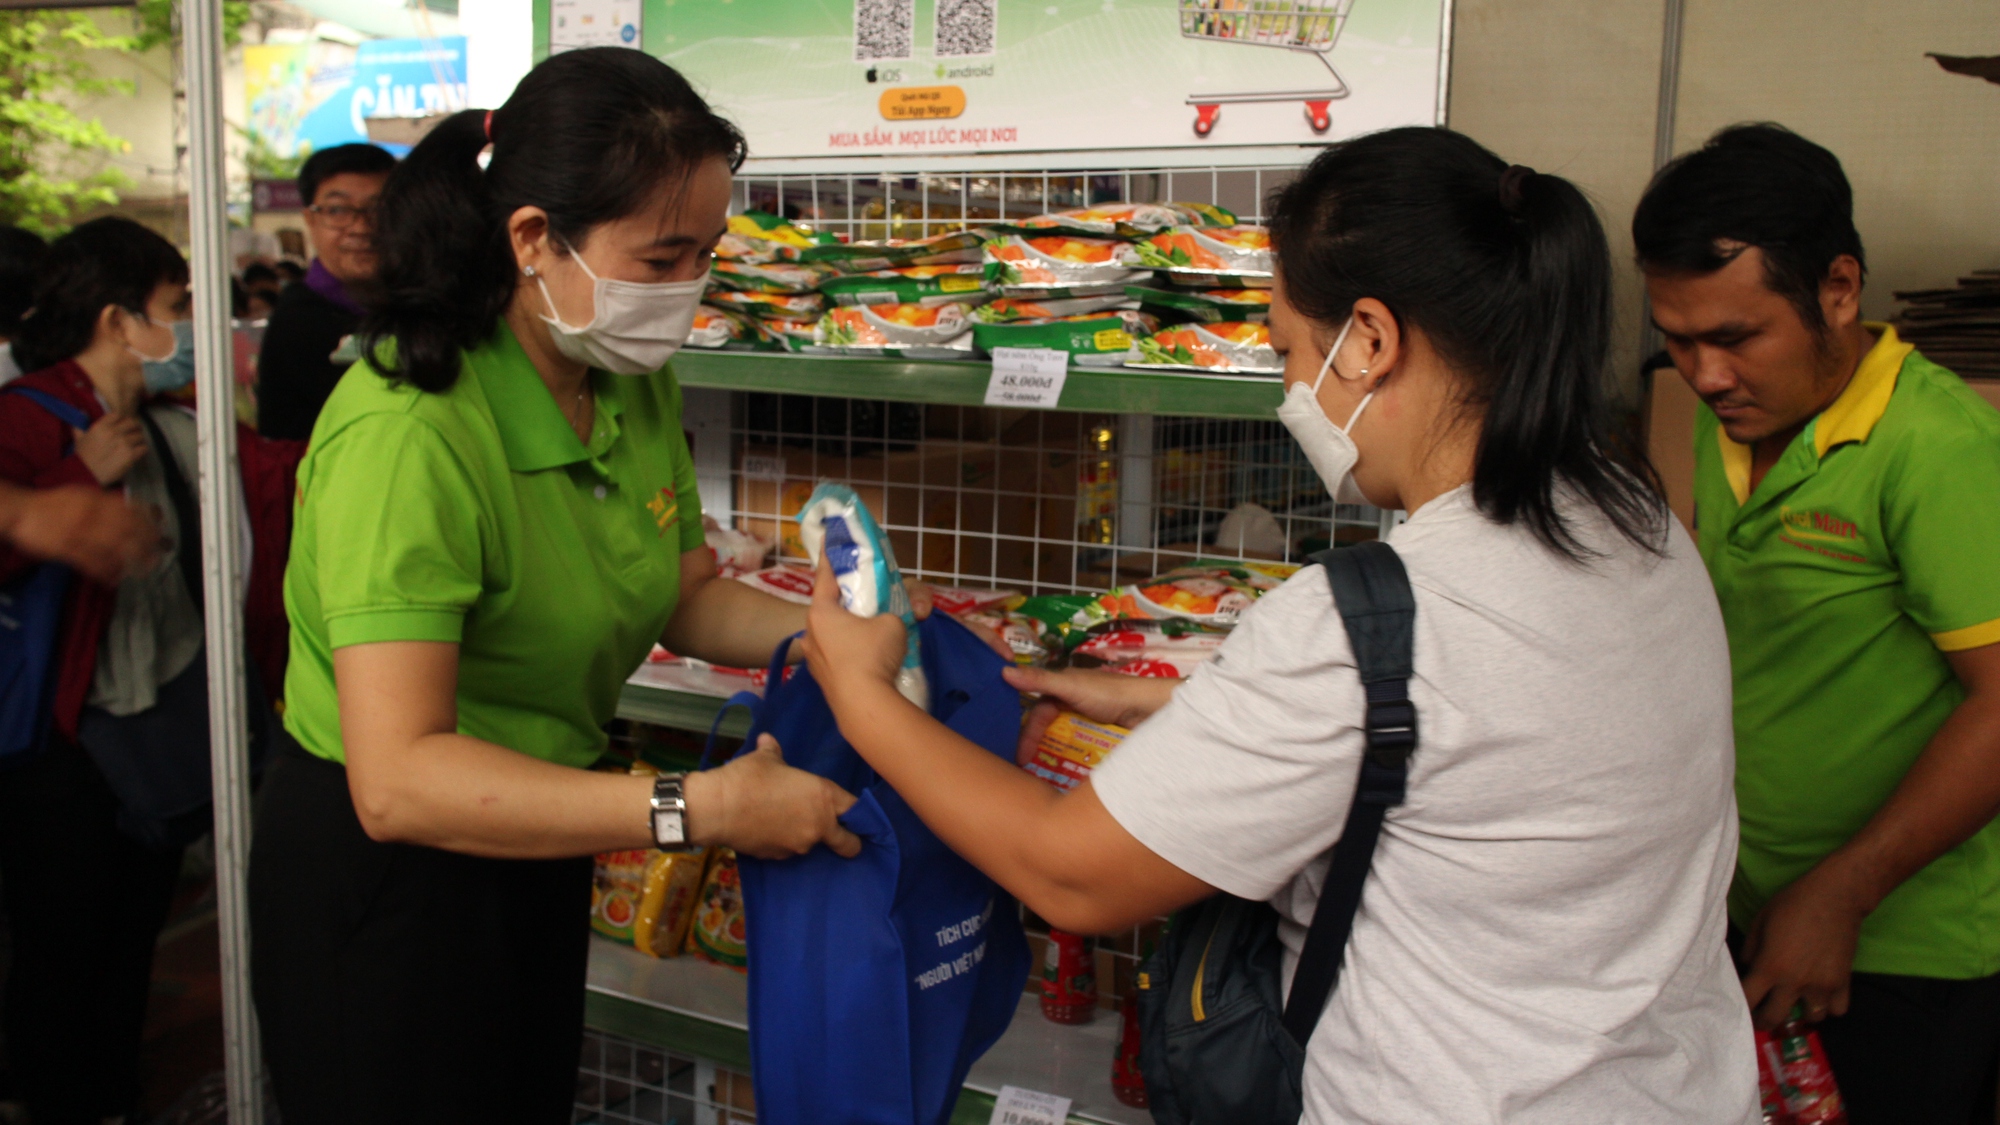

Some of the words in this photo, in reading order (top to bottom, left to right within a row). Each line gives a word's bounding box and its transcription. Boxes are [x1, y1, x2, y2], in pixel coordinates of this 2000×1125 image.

[882, 69, 902, 82] iOS
[947, 65, 994, 79] android
[829, 132, 861, 148] MUA
[863, 125, 893, 145] SẮM
[899, 130, 926, 148] MỌI
[929, 126, 956, 145] LÚC
[960, 128, 988, 146] MỌI
[991, 127, 1017, 143] NƠI
[935, 926, 962, 947] TÍCH
